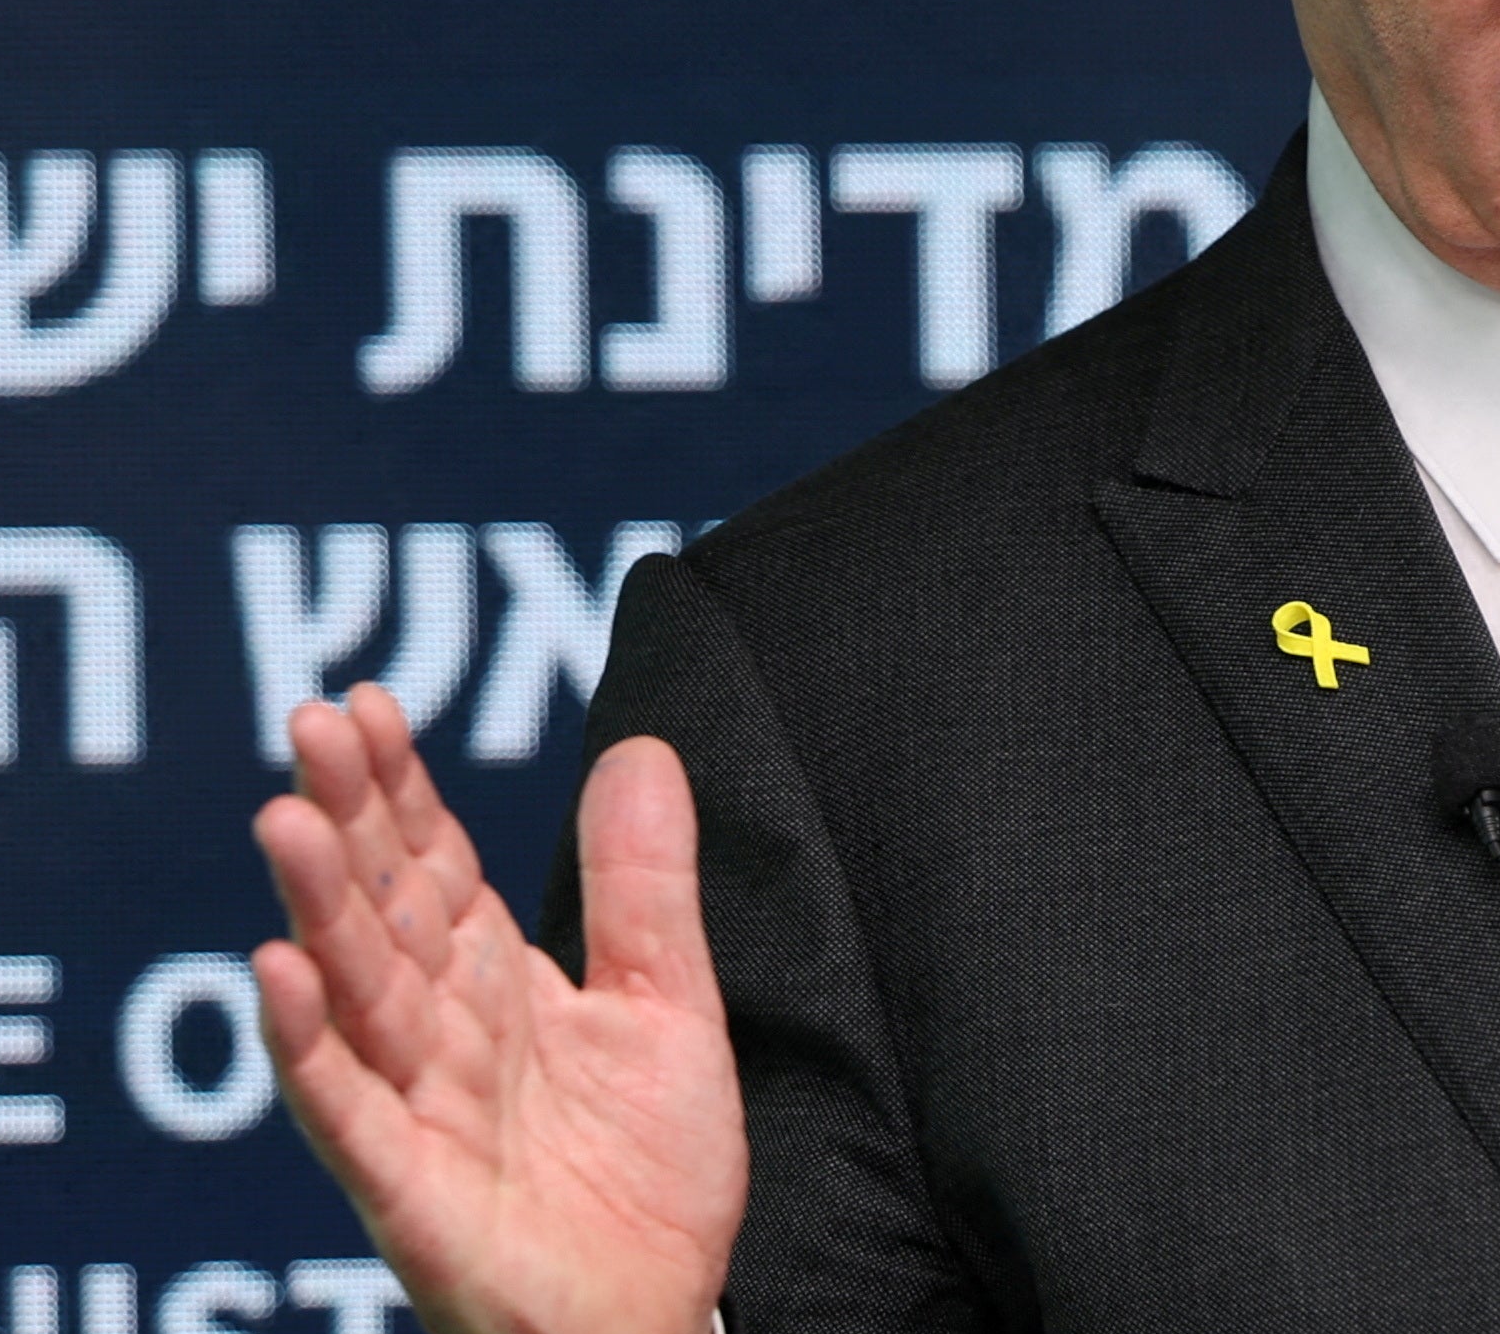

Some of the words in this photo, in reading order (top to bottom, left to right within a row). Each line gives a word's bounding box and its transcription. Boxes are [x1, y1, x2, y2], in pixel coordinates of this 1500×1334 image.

[358, 141, 1255, 393] מדינת
[230, 520, 722, 767] אש
[116, 951, 276, 1141] O
